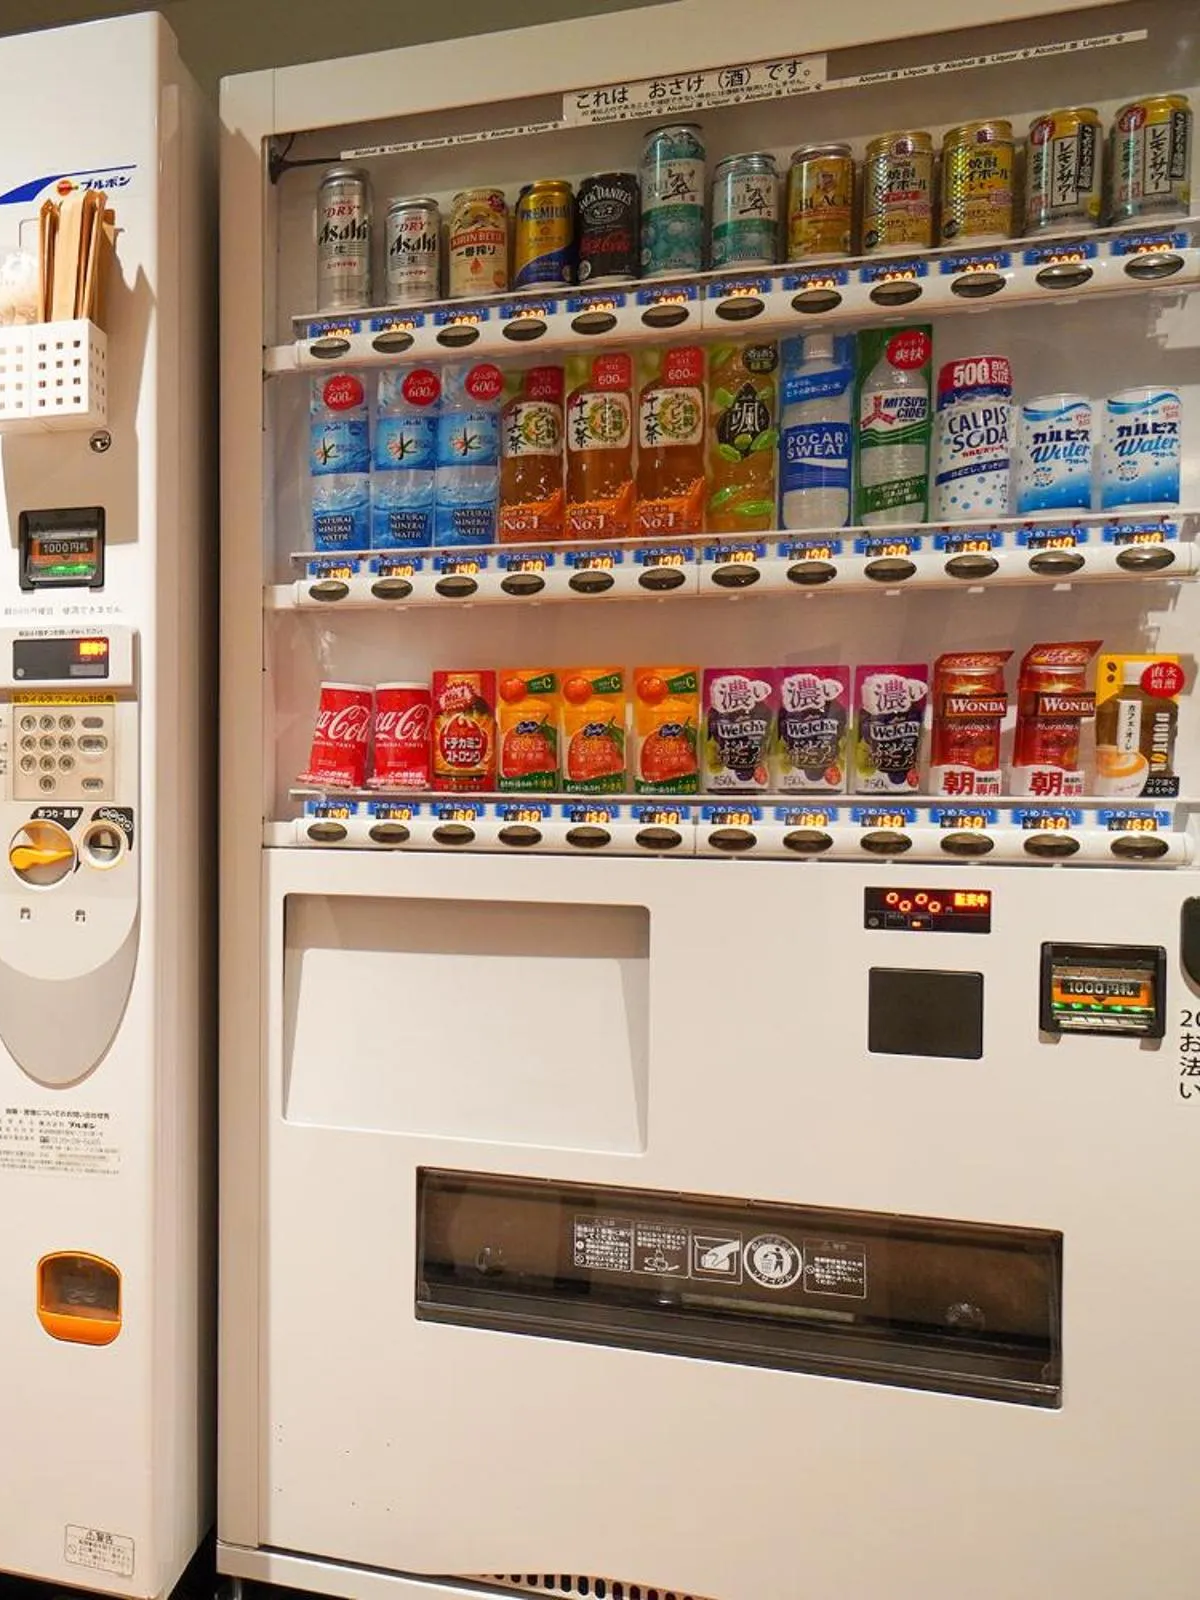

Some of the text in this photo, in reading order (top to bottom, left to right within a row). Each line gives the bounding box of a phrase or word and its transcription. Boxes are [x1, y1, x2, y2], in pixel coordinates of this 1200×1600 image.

[577, 87, 629, 110] これは
[650, 76, 704, 100] おさけ
[1149, 127, 1168, 190] レモンサワー
[1057, 141, 1075, 202] レモンサワー
[81, 175, 130, 191] ブルボン
[662, 168, 696, 200] 翠
[739, 182, 772, 215] 翠
[318, 219, 368, 245] Asahi
[389, 233, 436, 256] Asahi
[456, 245, 496, 257] 一番搾り
[991, 360, 1008, 374] BIG
[991, 371, 1009, 384] SIZE
[573, 398, 592, 448] 十六茶
[644, 393, 663, 444] 十六茶
[730, 400, 760, 432] 颯
[948, 406, 1008, 435] CALPIS
[507, 408, 526, 455] 十六茶
[1032, 428, 1090, 445] カルピス
[1116, 421, 1178, 436] カルピス
[787, 431, 848, 446] POCARI
[951, 426, 1009, 453] SODA
[1114, 435, 1179, 457] Water
[786, 443, 844, 460] SWEAT
[1030, 441, 1091, 463] Water
[502, 515, 539, 530] No.1
[569, 514, 605, 530] No.1
[638, 512, 675, 528] No.1
[1150, 667, 1177, 678] 直火
[1150, 678, 1176, 690] 焙煎
[719, 678, 769, 709] 濃い
[787, 677, 840, 709] 濃い
[874, 678, 925, 710] 濃い
[950, 698, 1005, 713] WONDA
[1044, 698, 1094, 713] WONDA
[719, 720, 766, 737] Welch's
[788, 720, 837, 737] Welch's
[872, 721, 918, 739] Welch's
[443, 737, 483, 750] ドデカミン
[445, 750, 482, 763] ストロング
[943, 771, 974, 796] 朝
[1029, 771, 1061, 796] 朝
[1146, 777, 1175, 787] コク深く
[1146, 786, 1175, 795] まろやか
[1068, 981, 1134, 995] 1000円札
